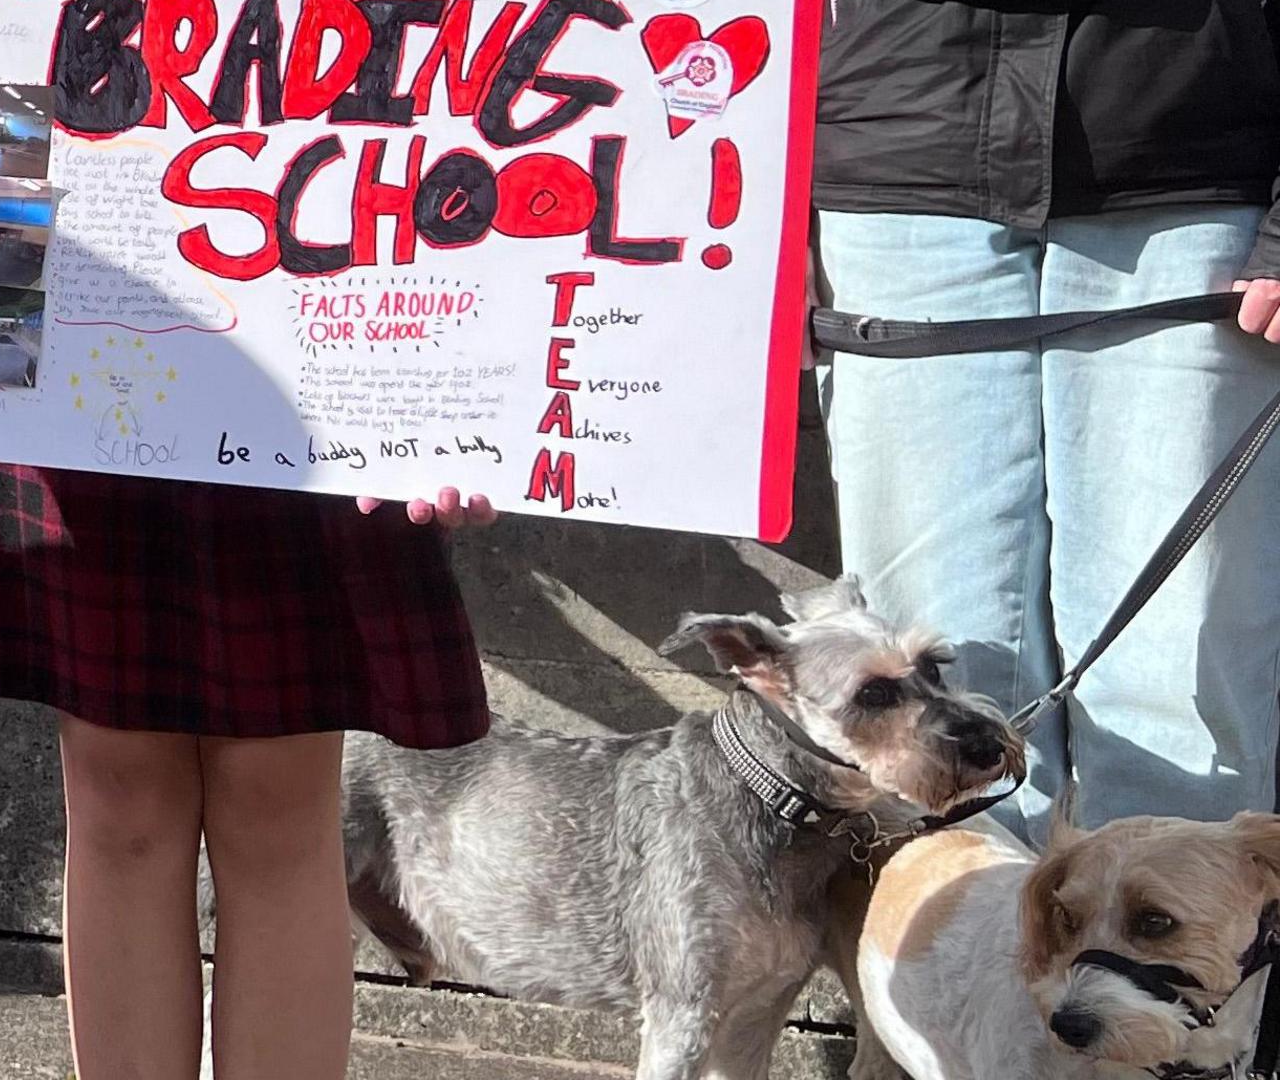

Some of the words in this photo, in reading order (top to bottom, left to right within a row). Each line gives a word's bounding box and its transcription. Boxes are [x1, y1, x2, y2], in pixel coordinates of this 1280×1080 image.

[300, 293, 367, 319] FACTS
[375, 291, 475, 319] AROUND
[545, 271, 644, 334] Together
[308, 321, 355, 343] OUR
[364, 319, 431, 342] SCHOOL
[545, 336, 663, 401] Everyone
[217, 431, 252, 466] be
[274, 451, 296, 468] a
[307, 434, 367, 470] buddy
[379, 437, 420, 459] NOT
[434, 446, 451, 457] a
[455, 433, 504, 464] bully
